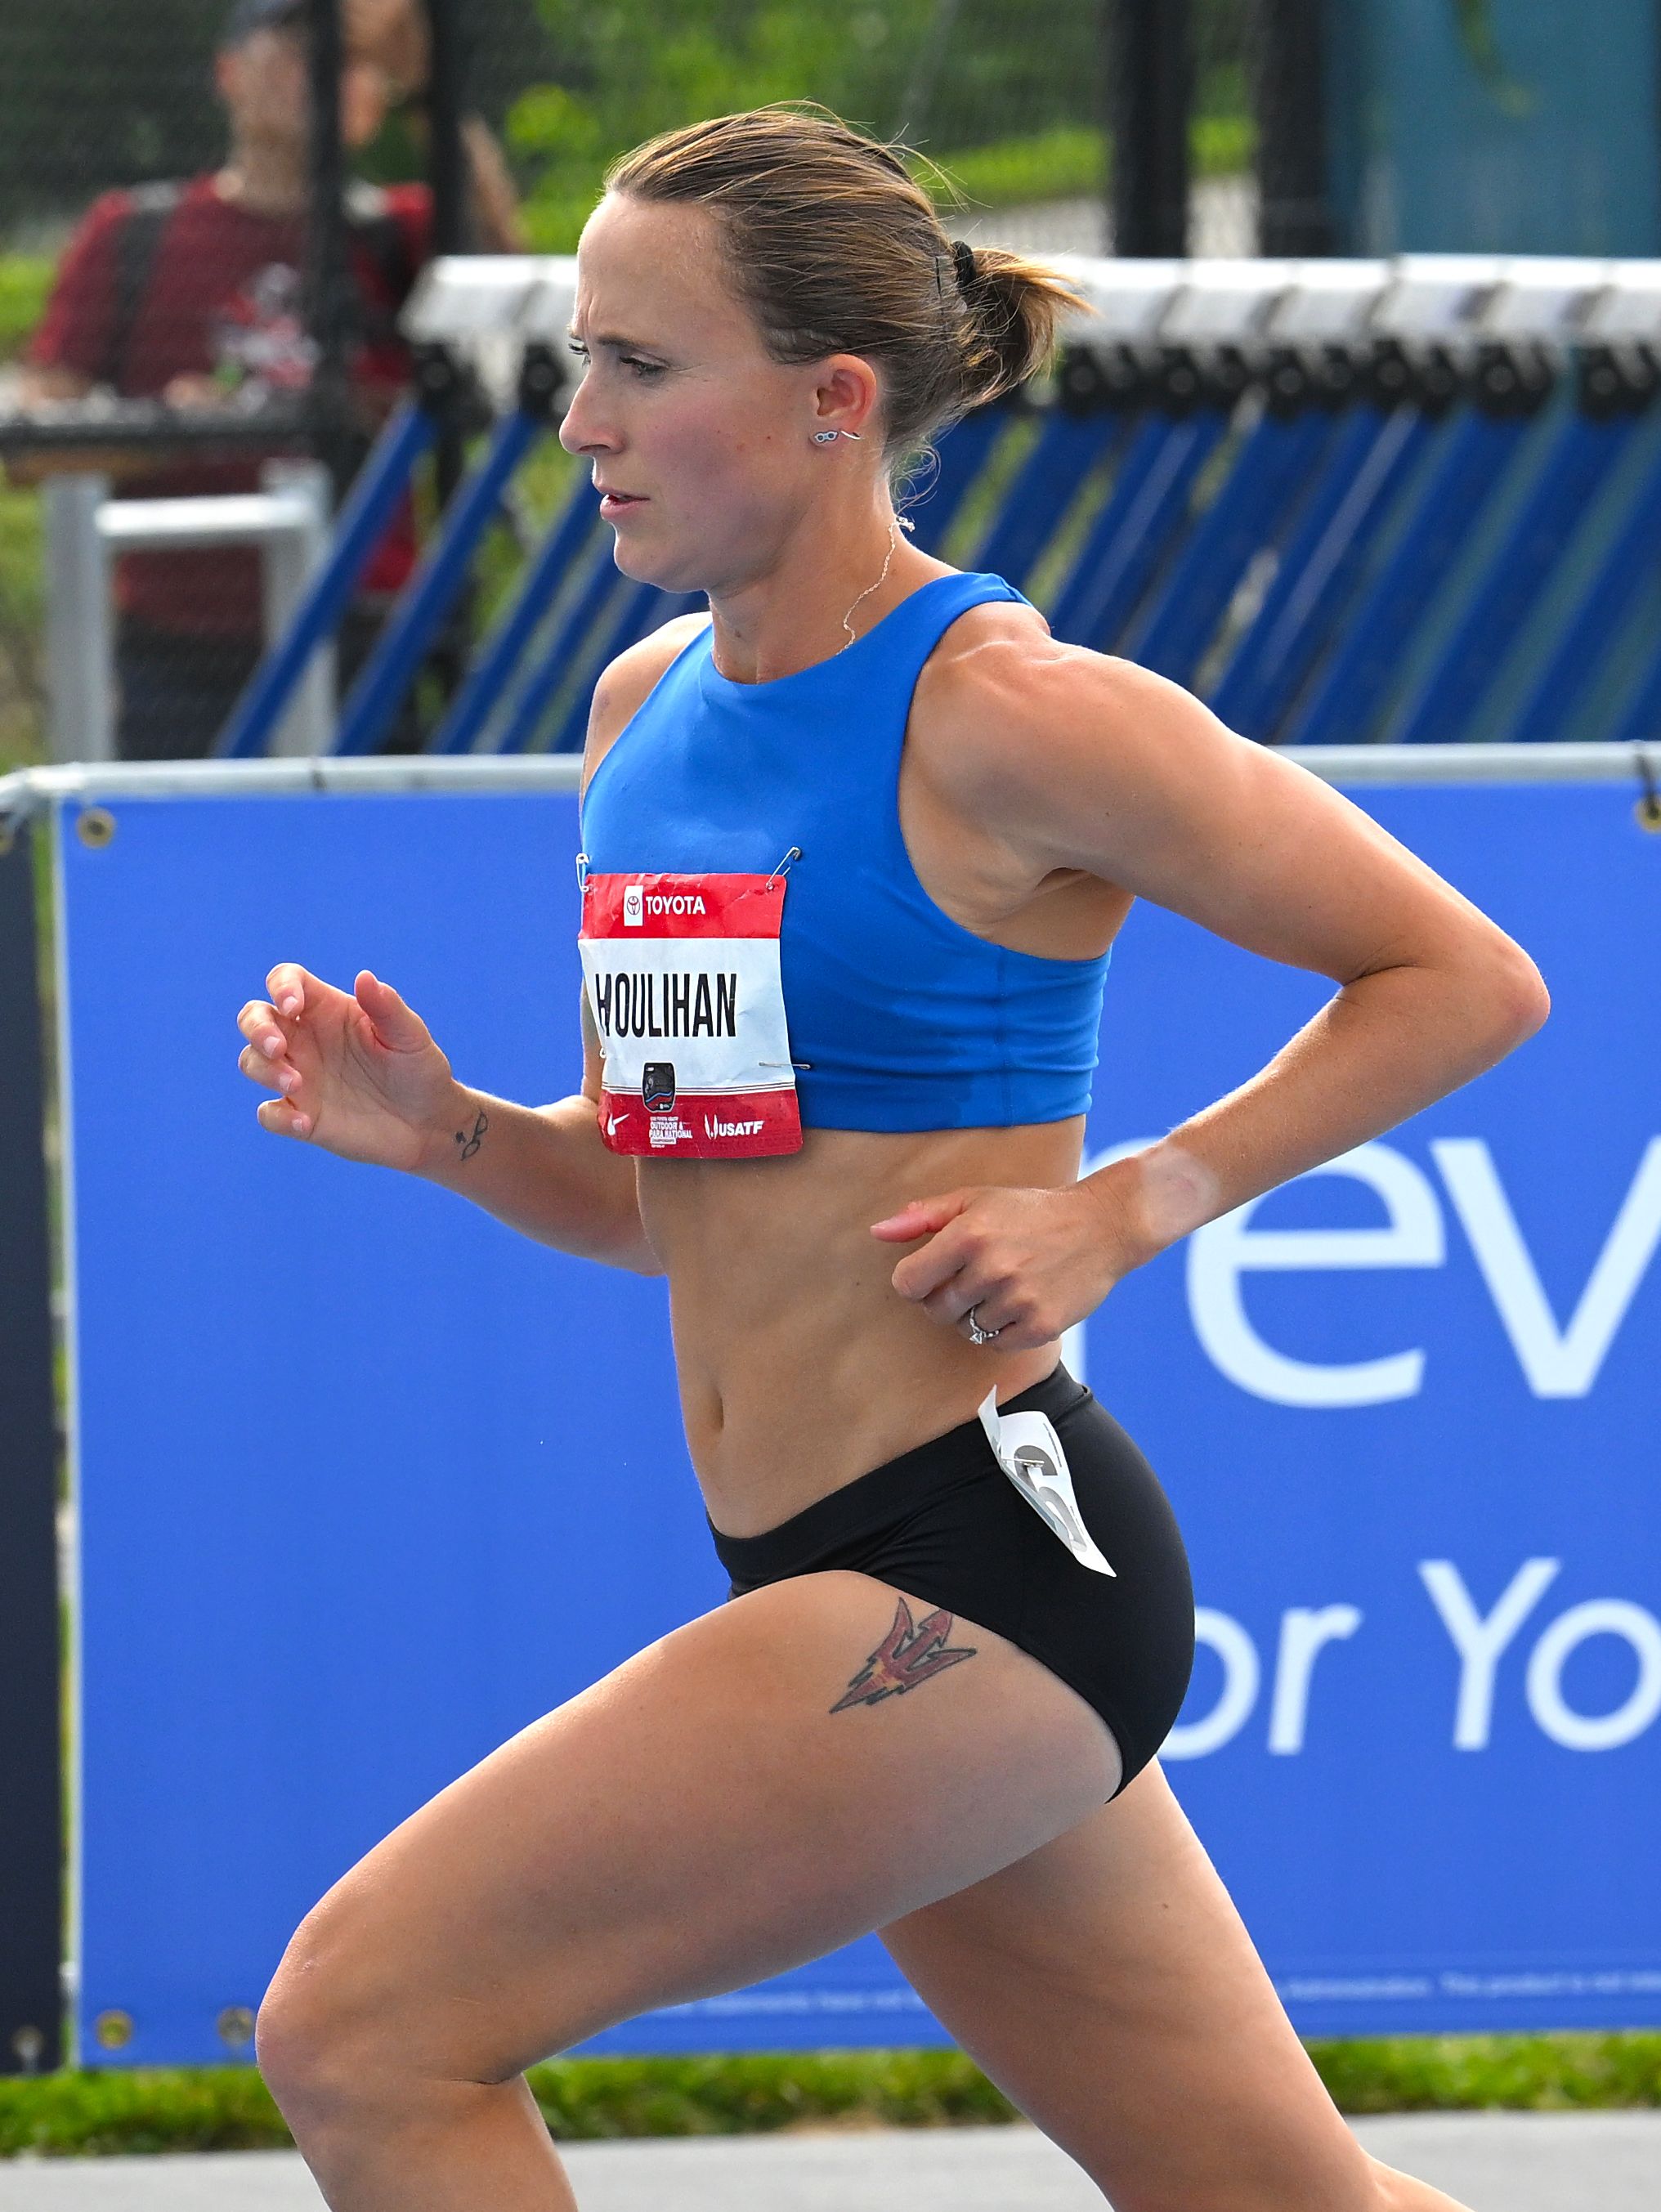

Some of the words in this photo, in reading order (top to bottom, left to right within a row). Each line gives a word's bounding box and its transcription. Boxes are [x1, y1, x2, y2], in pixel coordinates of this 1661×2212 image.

[646, 895, 706, 916] TOYOTA
[595, 973, 737, 1037] HOULIHAN
[719, 1121, 763, 1136] USATF
